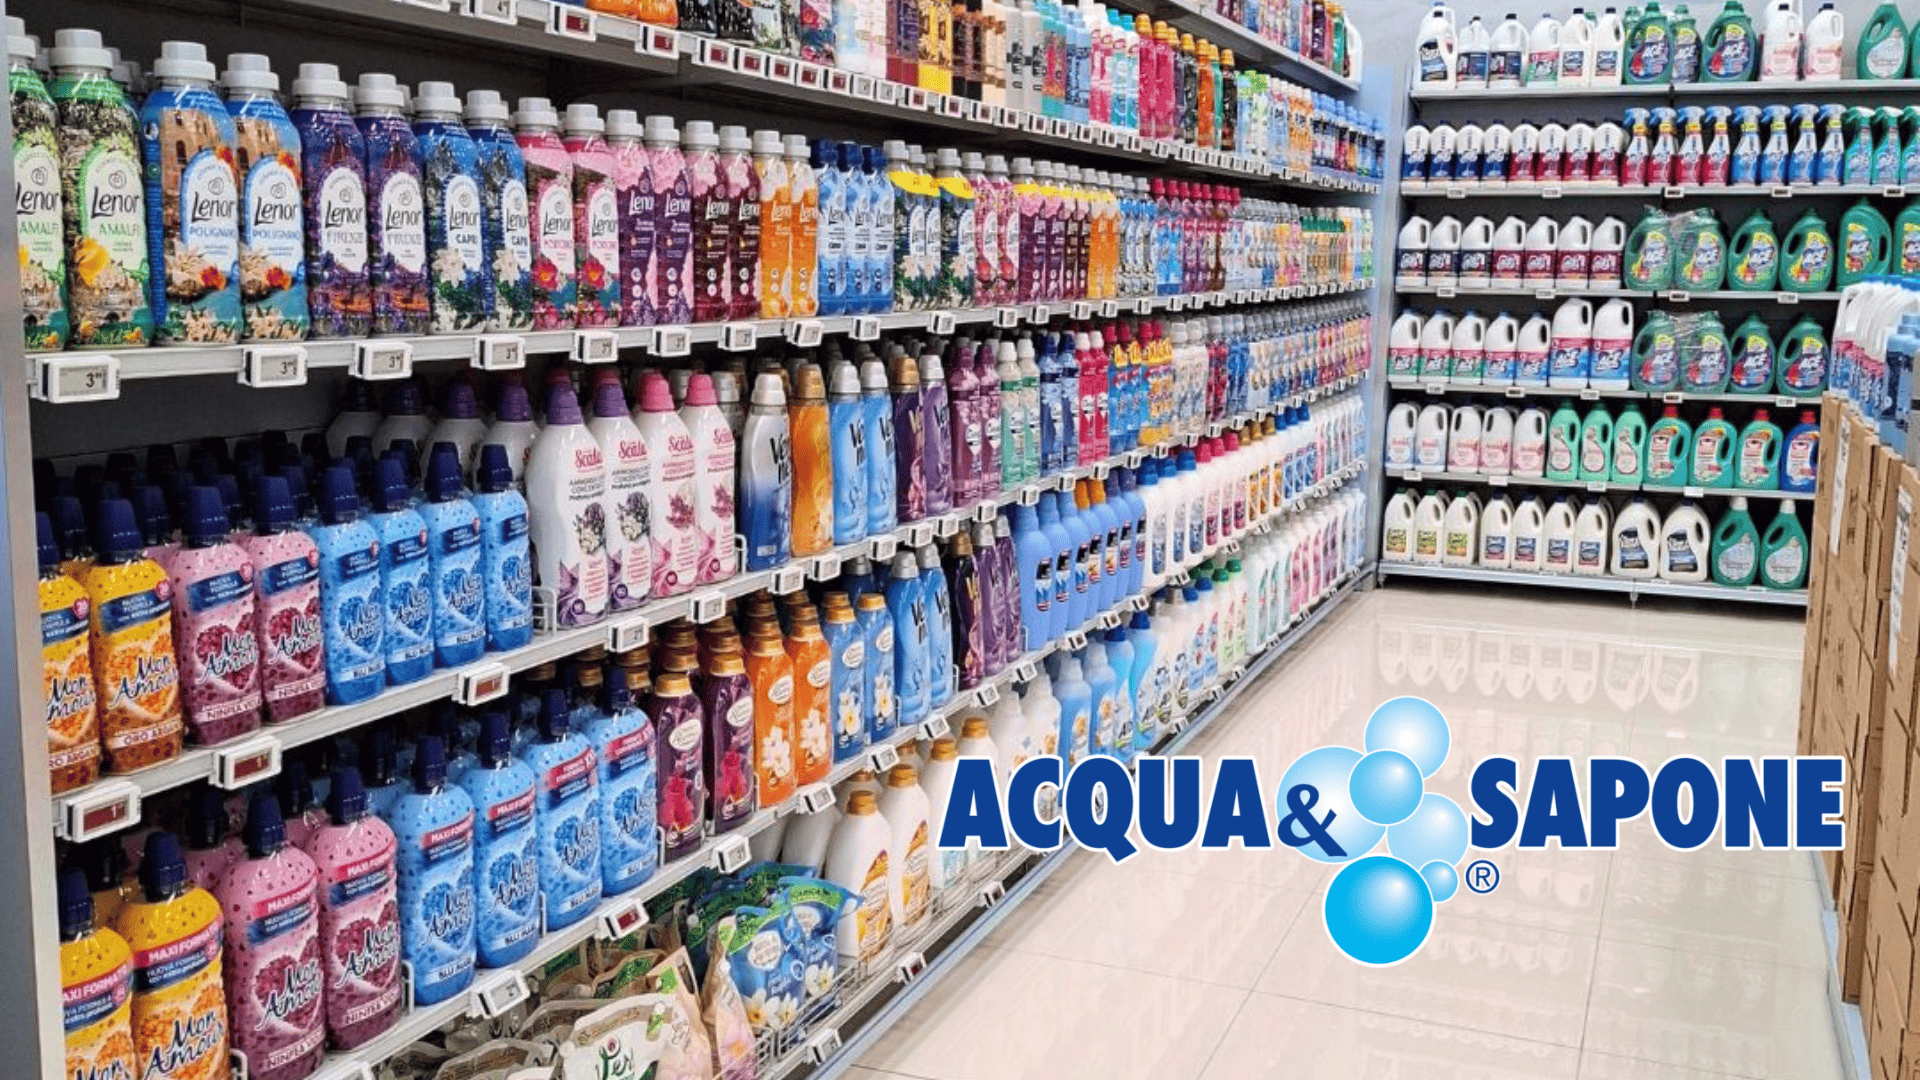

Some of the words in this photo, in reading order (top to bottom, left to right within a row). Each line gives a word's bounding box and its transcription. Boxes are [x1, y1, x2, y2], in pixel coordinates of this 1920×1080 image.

[90, 186, 140, 219] Lenor
[191, 191, 235, 223] Lenor
[254, 197, 298, 226] Lenor
[325, 201, 363, 229] Lenor
[385, 204, 422, 231] Lenor
[450, 205, 479, 231] Lenor
[294, 615, 320, 640] Mon
[222, 632, 254, 654] Mon
[136, 655, 171, 682] Mon
[195, 644, 259, 684] Amour
[51, 675, 86, 703] Mon
[107, 665, 179, 709] Amour
[148, 946, 174, 961] MAXI
[364, 921, 396, 957] Mon
[285, 959, 318, 995] Mon
[63, 989, 82, 1002] AXI
[254, 982, 321, 1031] Amour
[170, 1010, 214, 1048] Mon
[144, 1022, 224, 1080] Amour
